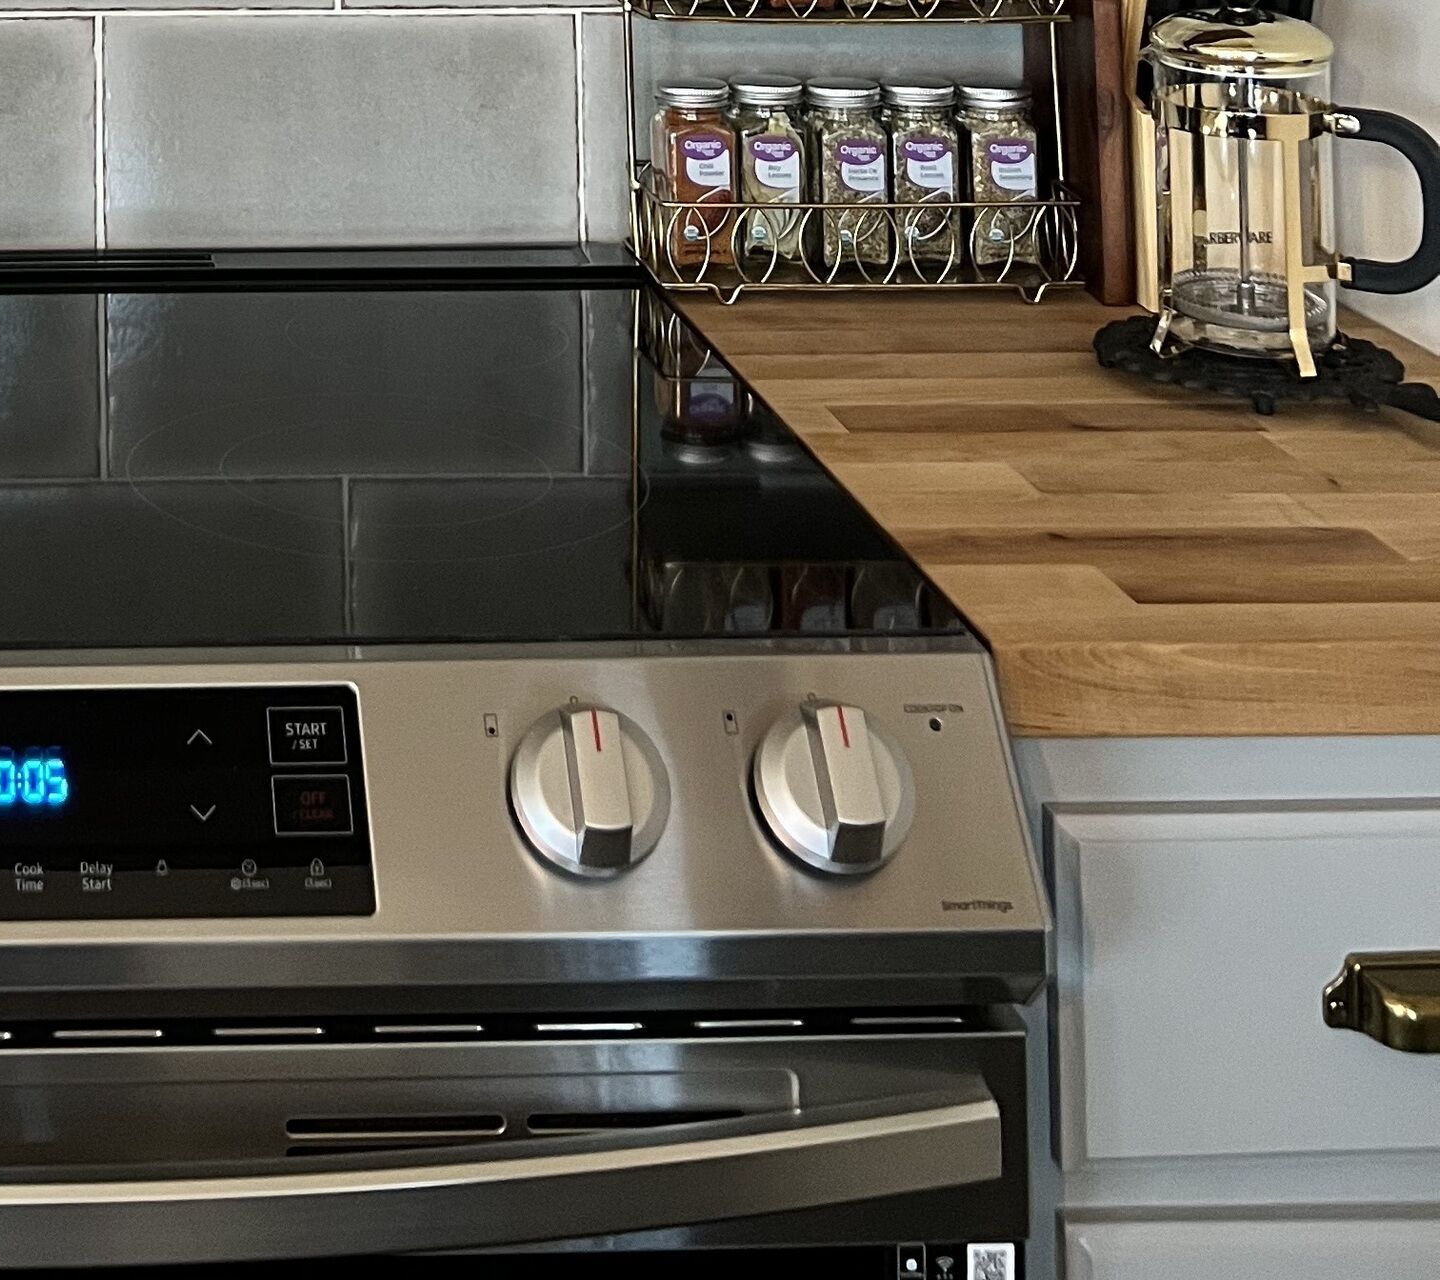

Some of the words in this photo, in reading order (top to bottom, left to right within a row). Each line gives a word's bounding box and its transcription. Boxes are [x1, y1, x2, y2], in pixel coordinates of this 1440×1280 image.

[285, 722, 327, 736] START
[14, 862, 44, 876] Cook
[80, 861, 113, 875] Delay
[15, 878, 44, 891] Time
[81, 877, 113, 891] Start
